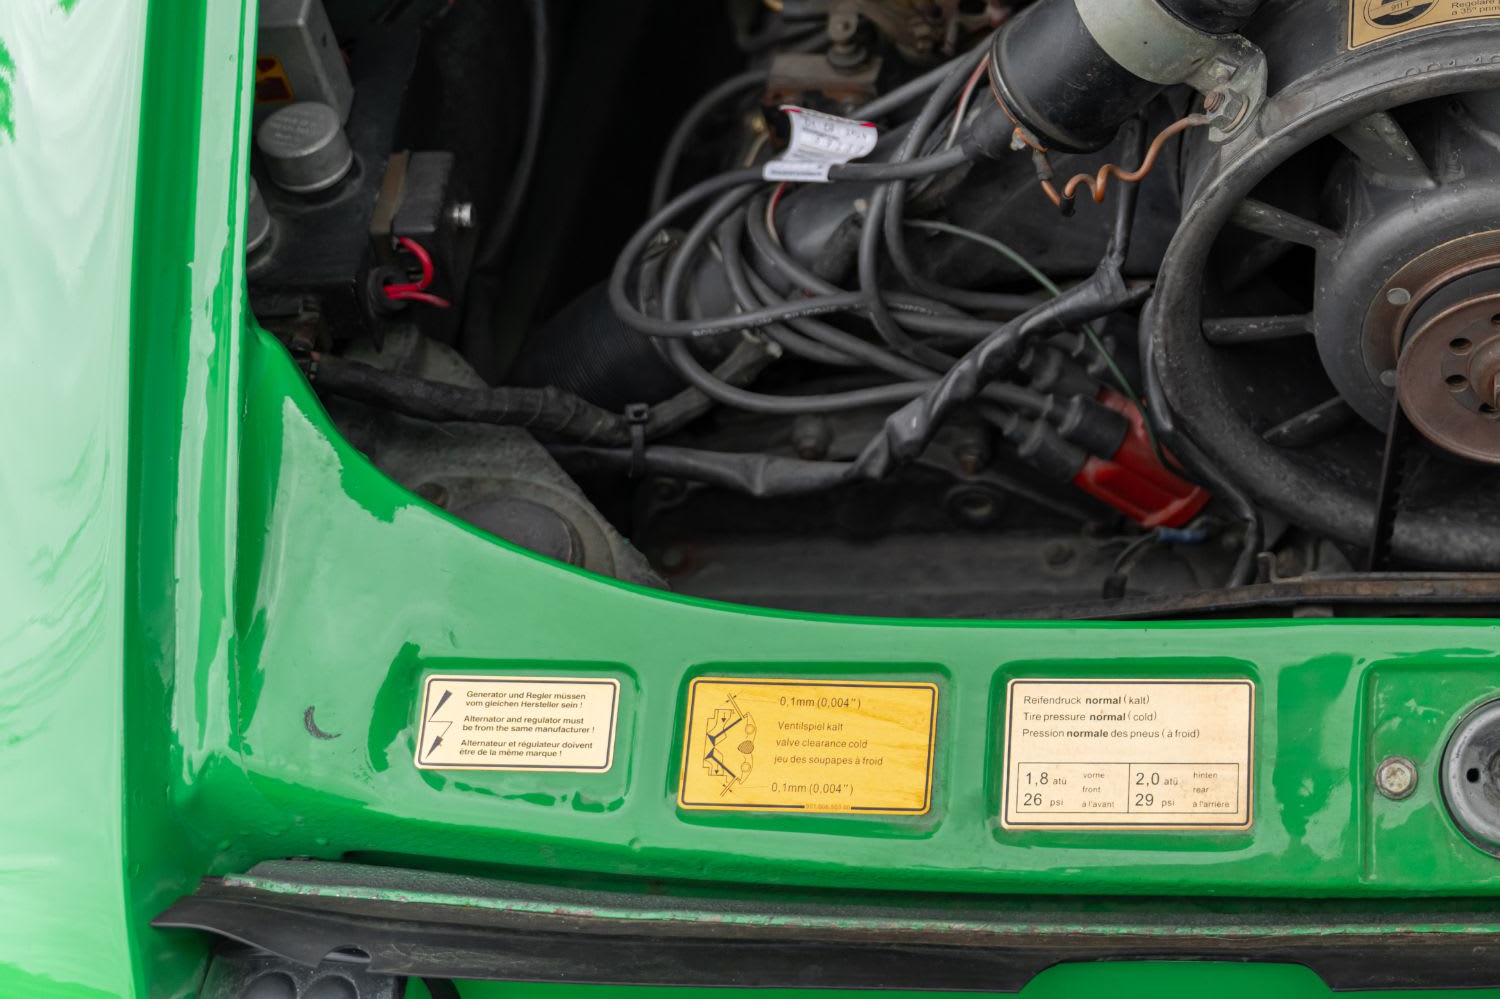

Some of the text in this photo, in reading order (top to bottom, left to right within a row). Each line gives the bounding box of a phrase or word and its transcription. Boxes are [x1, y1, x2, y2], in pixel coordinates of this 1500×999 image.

[1451, 0, 1495, 9] Regolare
[467, 691, 507, 699] Generator
[526, 692, 552, 701] Regler
[1024, 696, 1081, 704] Reifendruck
[1086, 696, 1121, 704] normal
[464, 716, 504, 724] Alternator
[524, 717, 561, 725] regulator
[1024, 713, 1041, 721] Tire
[1044, 714, 1085, 722] pressure
[1090, 713, 1125, 721] normal
[535, 726, 590, 734] manufacturer
[779, 721, 825, 731] Ventilspiel
[1023, 729, 1159, 739] Pression normale des pneus
[461, 740, 507, 748] Alternateur
[562, 741, 592, 749] doivent
[776, 739, 867, 748] valve clearance cold
[774, 756, 788, 764] jeu
[809, 757, 852, 766] soupapes
[863, 757, 883, 765] froid
[1026, 773, 1048, 786] 1,8
[1136, 773, 1160, 786] 2,0
[1193, 771, 1218, 779] hinten
[1024, 794, 1063, 808] 26 psi
[1135, 794, 1175, 808] 29 psi
